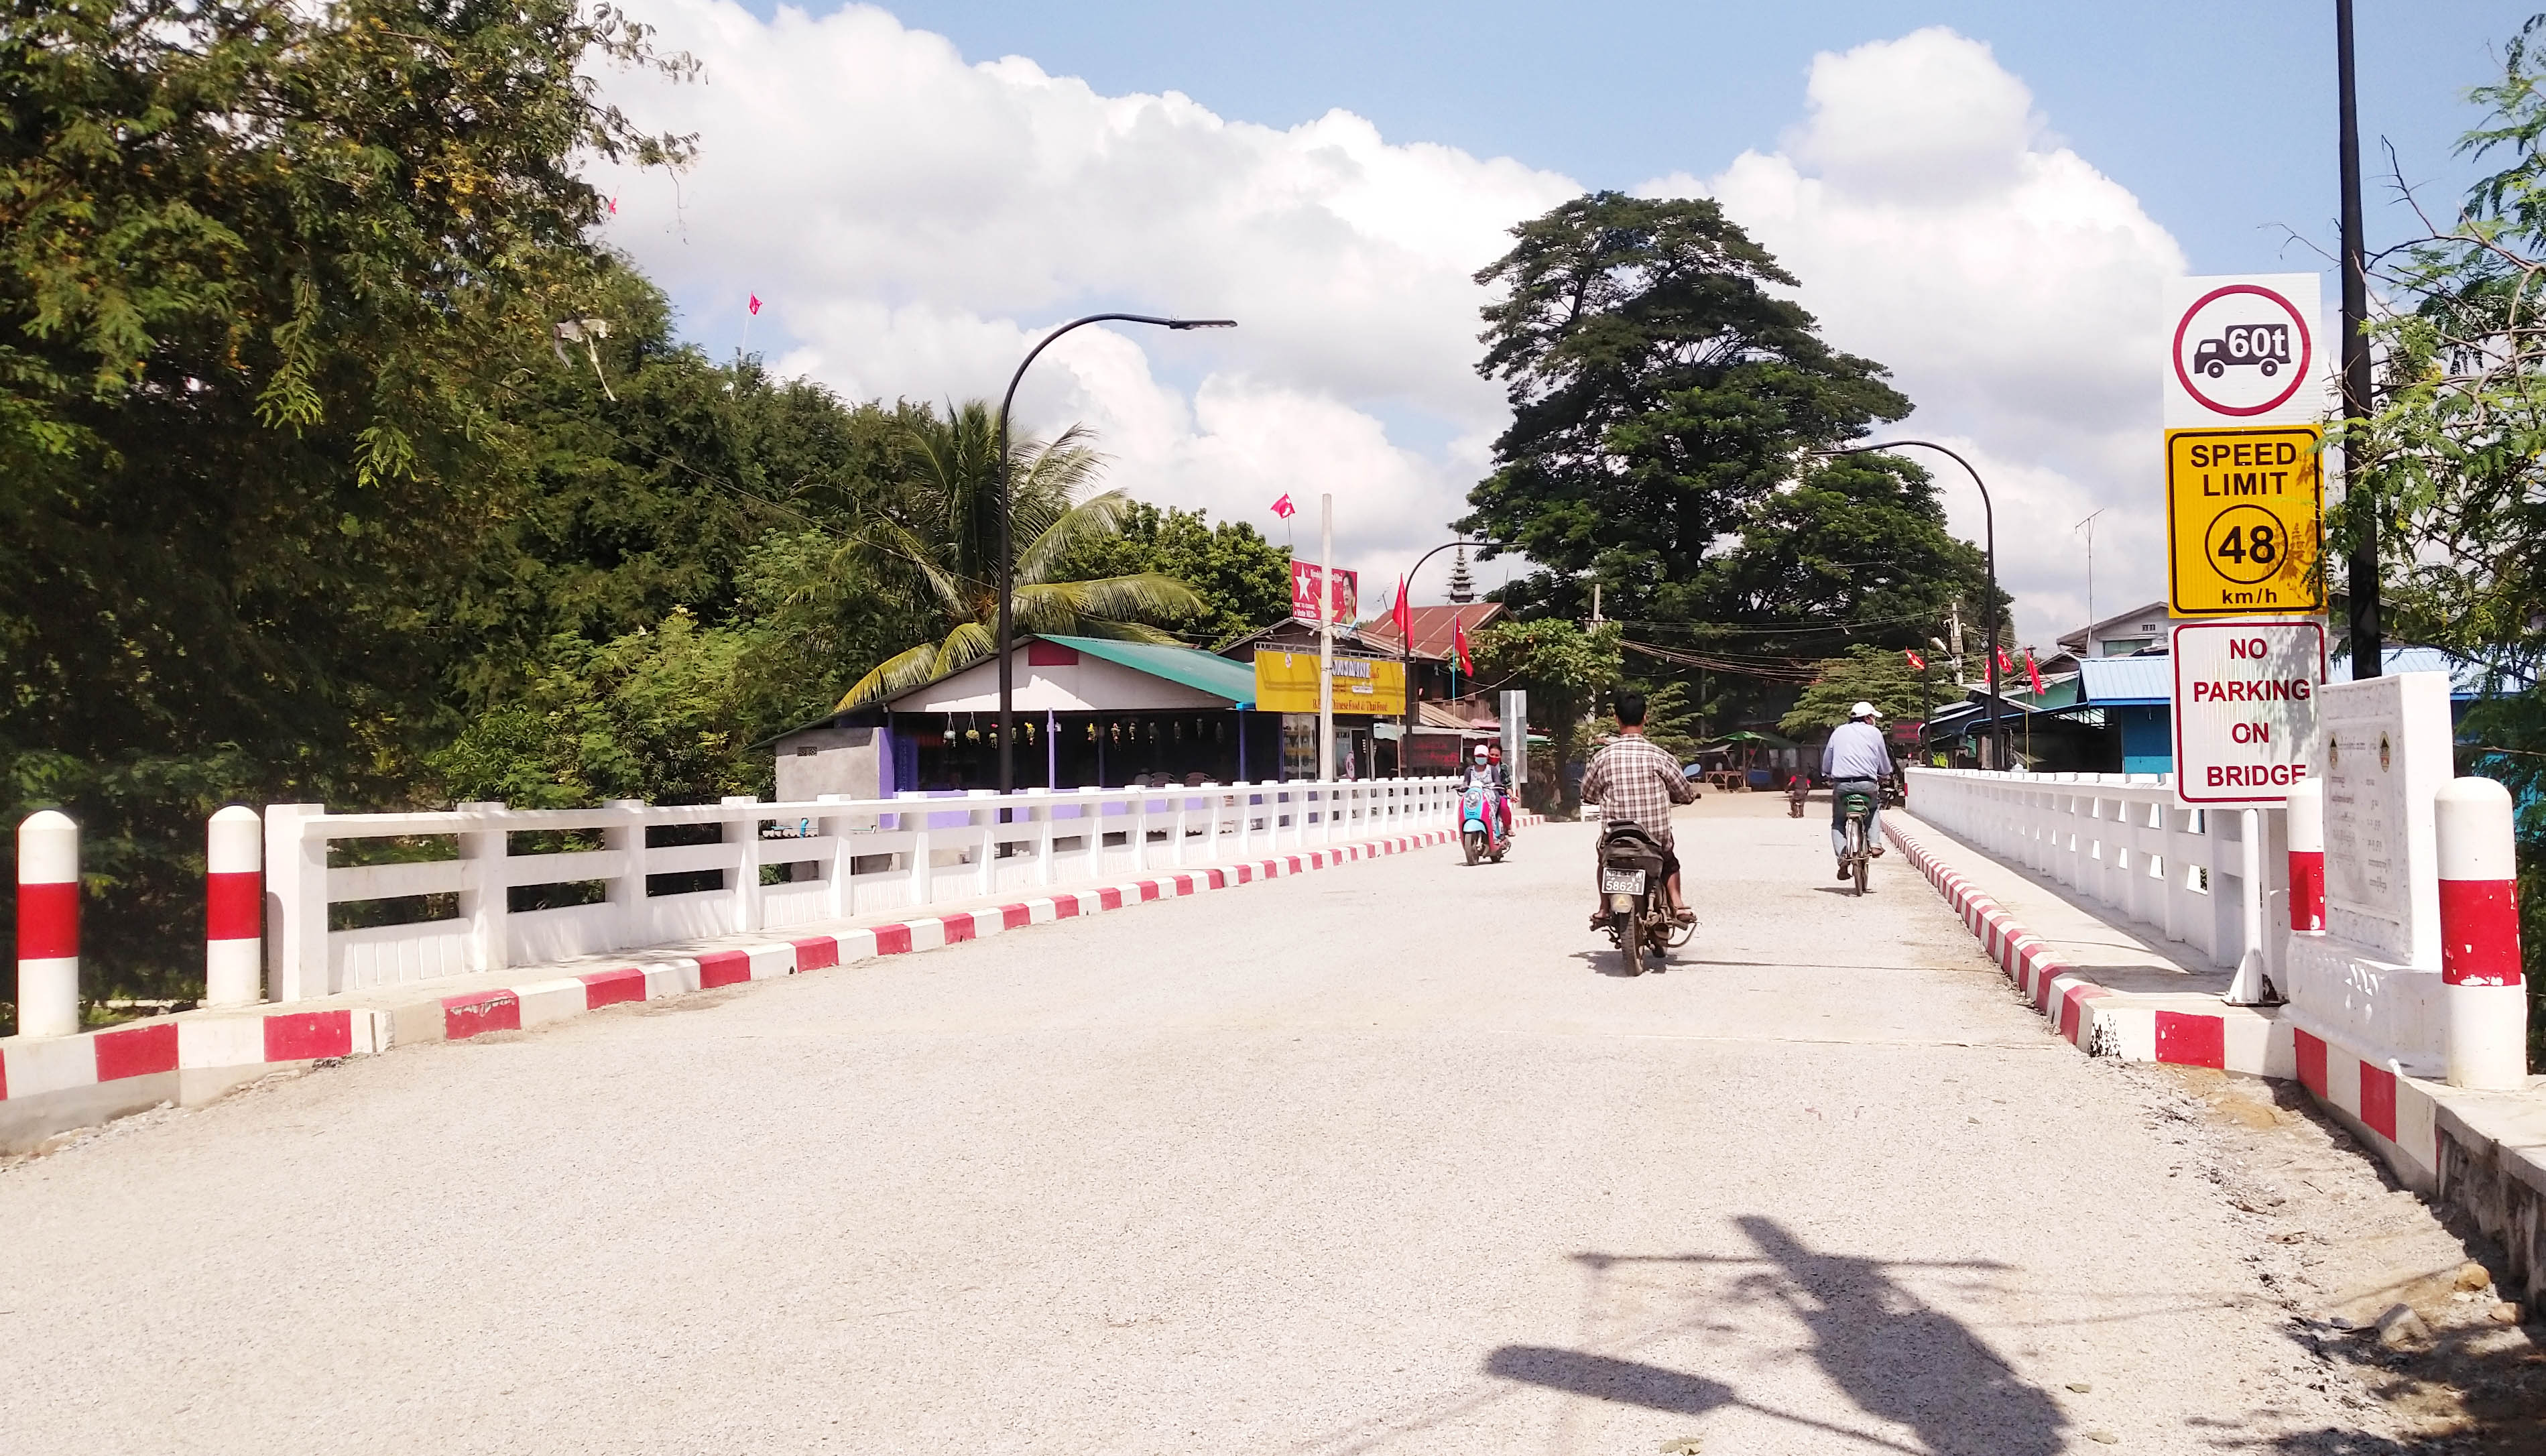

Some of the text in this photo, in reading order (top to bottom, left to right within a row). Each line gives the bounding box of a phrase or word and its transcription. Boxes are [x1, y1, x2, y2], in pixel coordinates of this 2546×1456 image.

[2228, 328, 2287, 358] 60t
[2191, 442, 2296, 468] SPEED
[2203, 472, 2287, 496] LIMIT
[2218, 525, 2275, 564] 48
[2222, 589, 2277, 604] km/h
[2230, 638, 2267, 659] NO
[2193, 679, 2310, 702] PARKING
[2232, 722, 2269, 743] ON
[2207, 765, 2306, 786] BRIDGE
[1605, 880, 1640, 892] 58621
